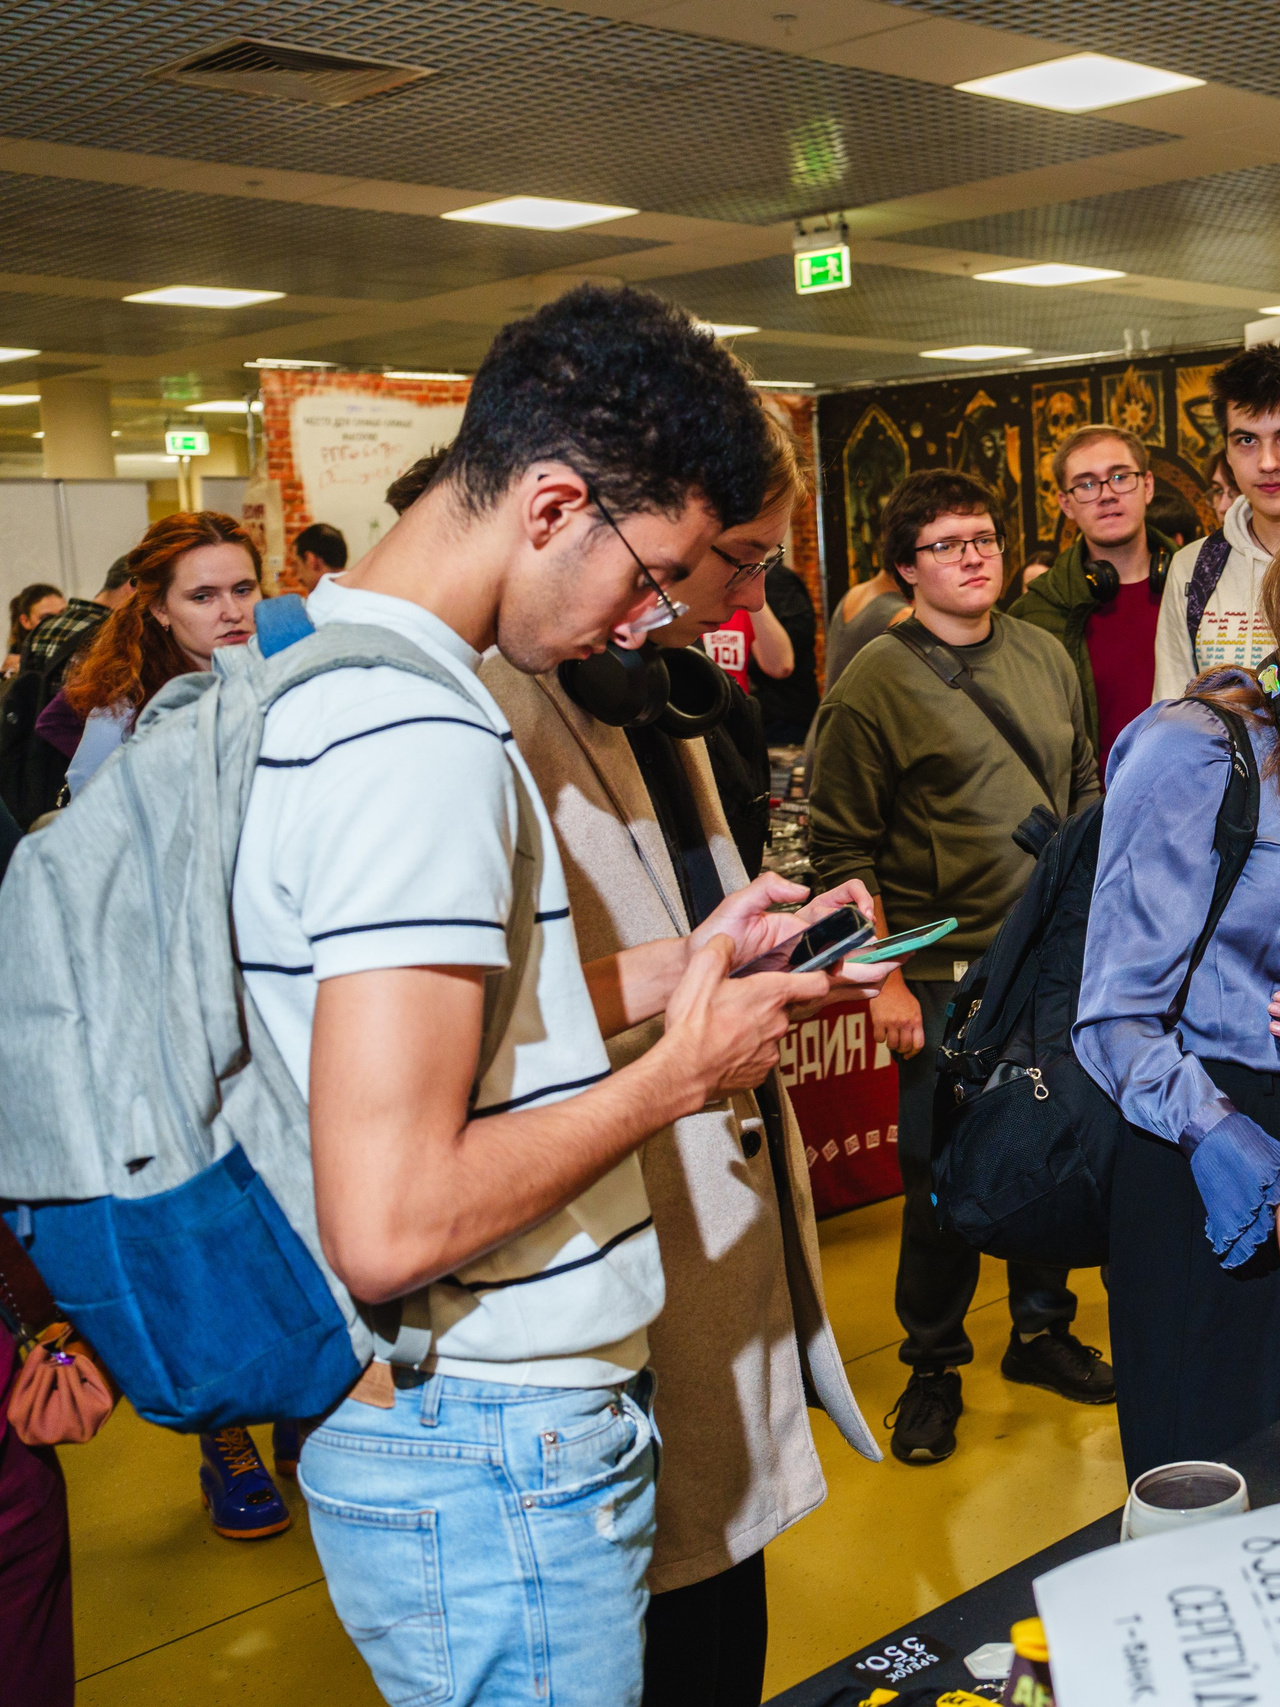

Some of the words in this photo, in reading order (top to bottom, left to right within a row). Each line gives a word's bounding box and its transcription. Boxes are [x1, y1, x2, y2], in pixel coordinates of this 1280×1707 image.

[713, 646, 738, 666] 101
[779, 1012, 866, 1088] УДИЯ
[1167, 1583, 1260, 1687] СЕРГЕЙ
